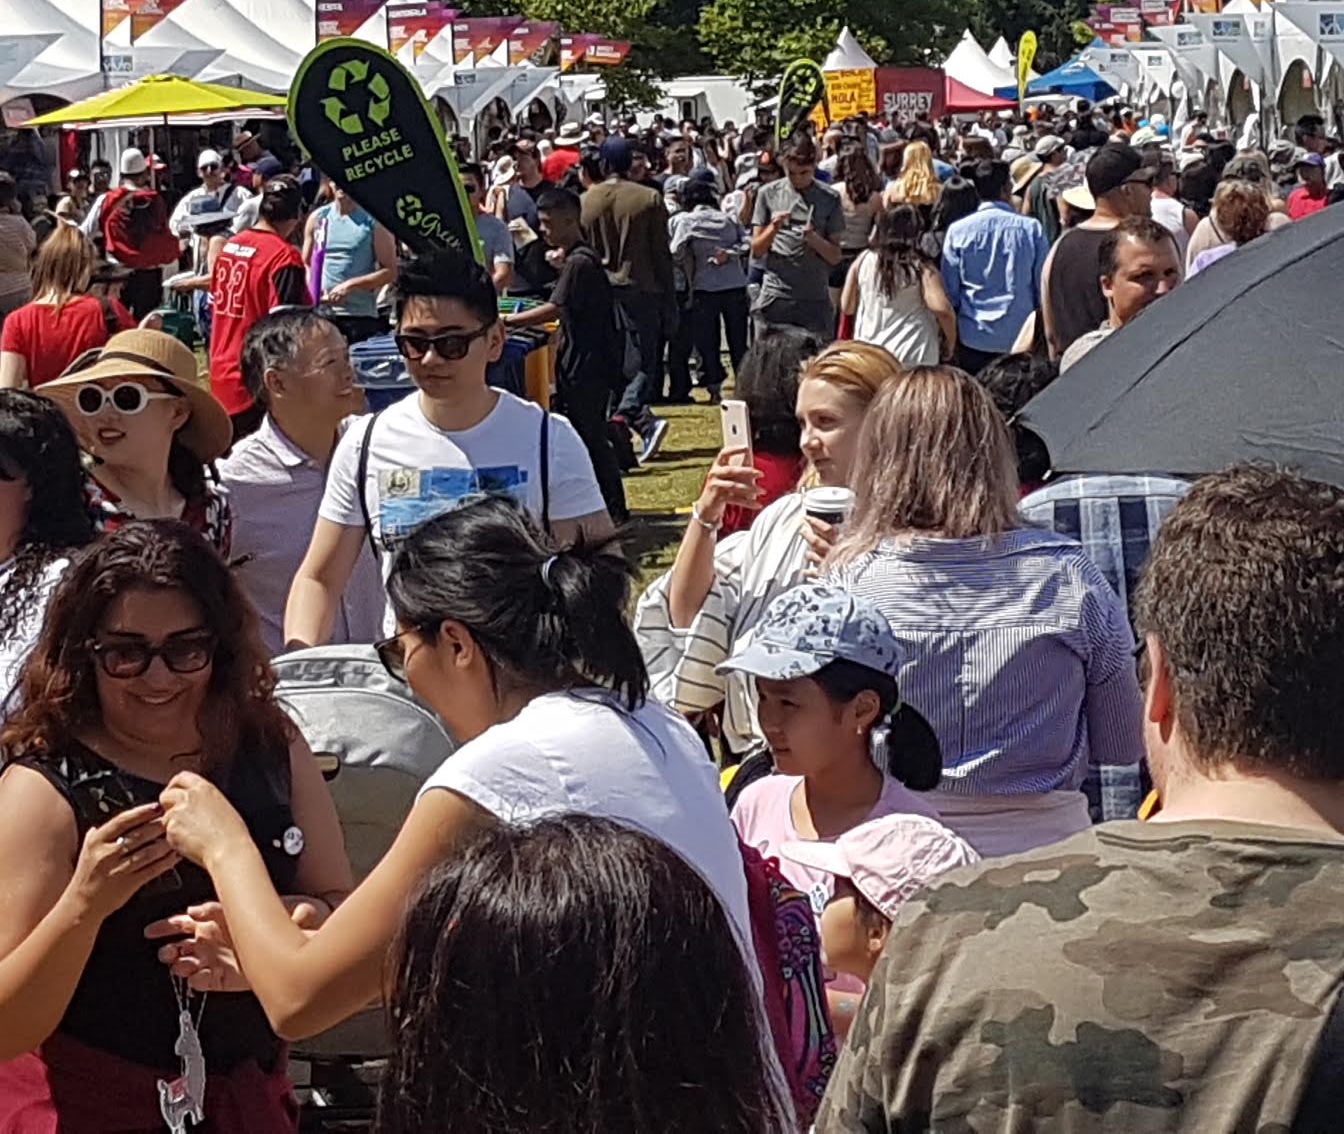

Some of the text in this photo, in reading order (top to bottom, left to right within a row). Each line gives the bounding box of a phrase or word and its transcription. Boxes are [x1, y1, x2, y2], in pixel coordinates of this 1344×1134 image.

[883, 91, 934, 108] SURREY
[342, 127, 402, 162] PLEASE
[344, 143, 415, 183] RECYCLE
